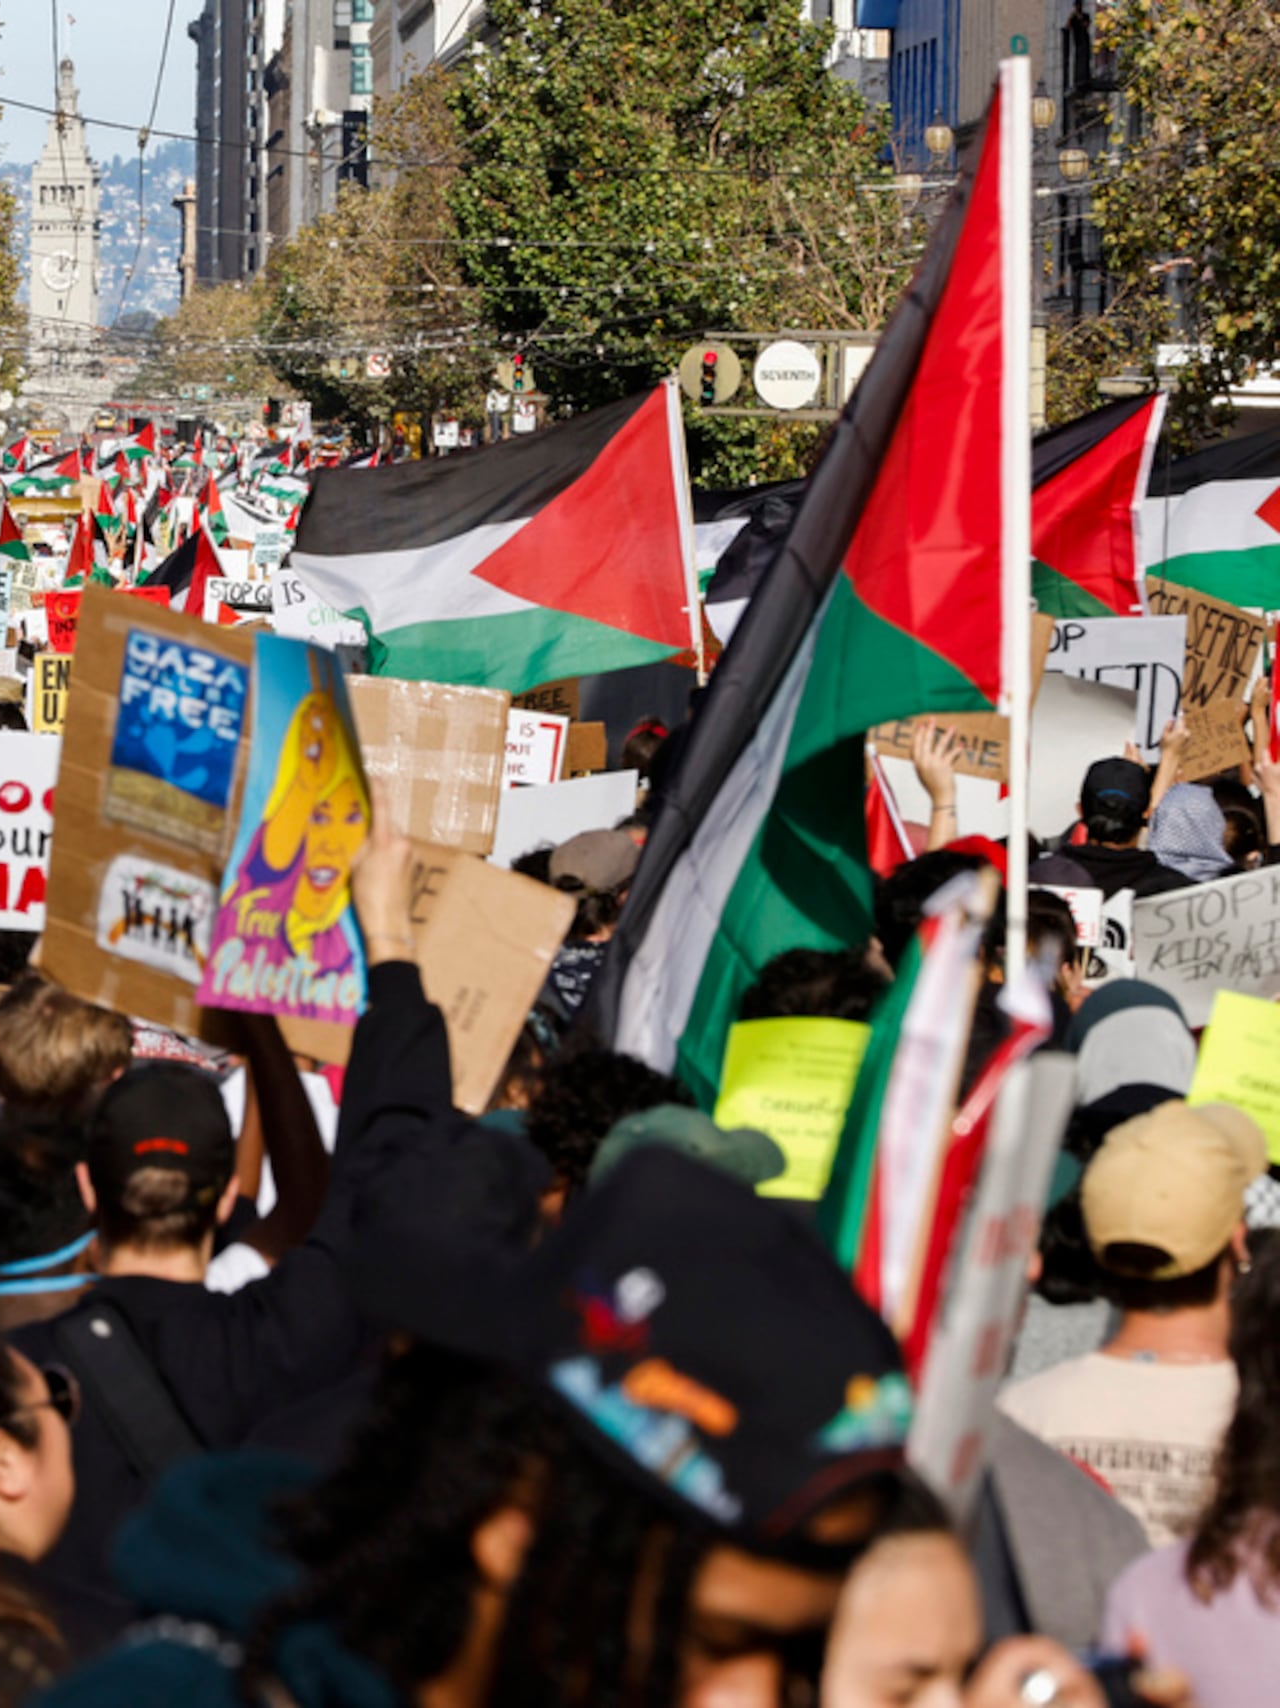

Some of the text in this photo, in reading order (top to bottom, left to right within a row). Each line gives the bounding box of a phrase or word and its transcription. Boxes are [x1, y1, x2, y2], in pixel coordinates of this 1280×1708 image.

[760, 370, 816, 381] SEVENTH
[281, 579, 306, 606] IS
[42, 659, 71, 691] EN
[128, 631, 246, 694] GAZA
[121, 674, 240, 742] FREE
[1143, 878, 1265, 938] STOP
[210, 937, 359, 1011] Palestine
